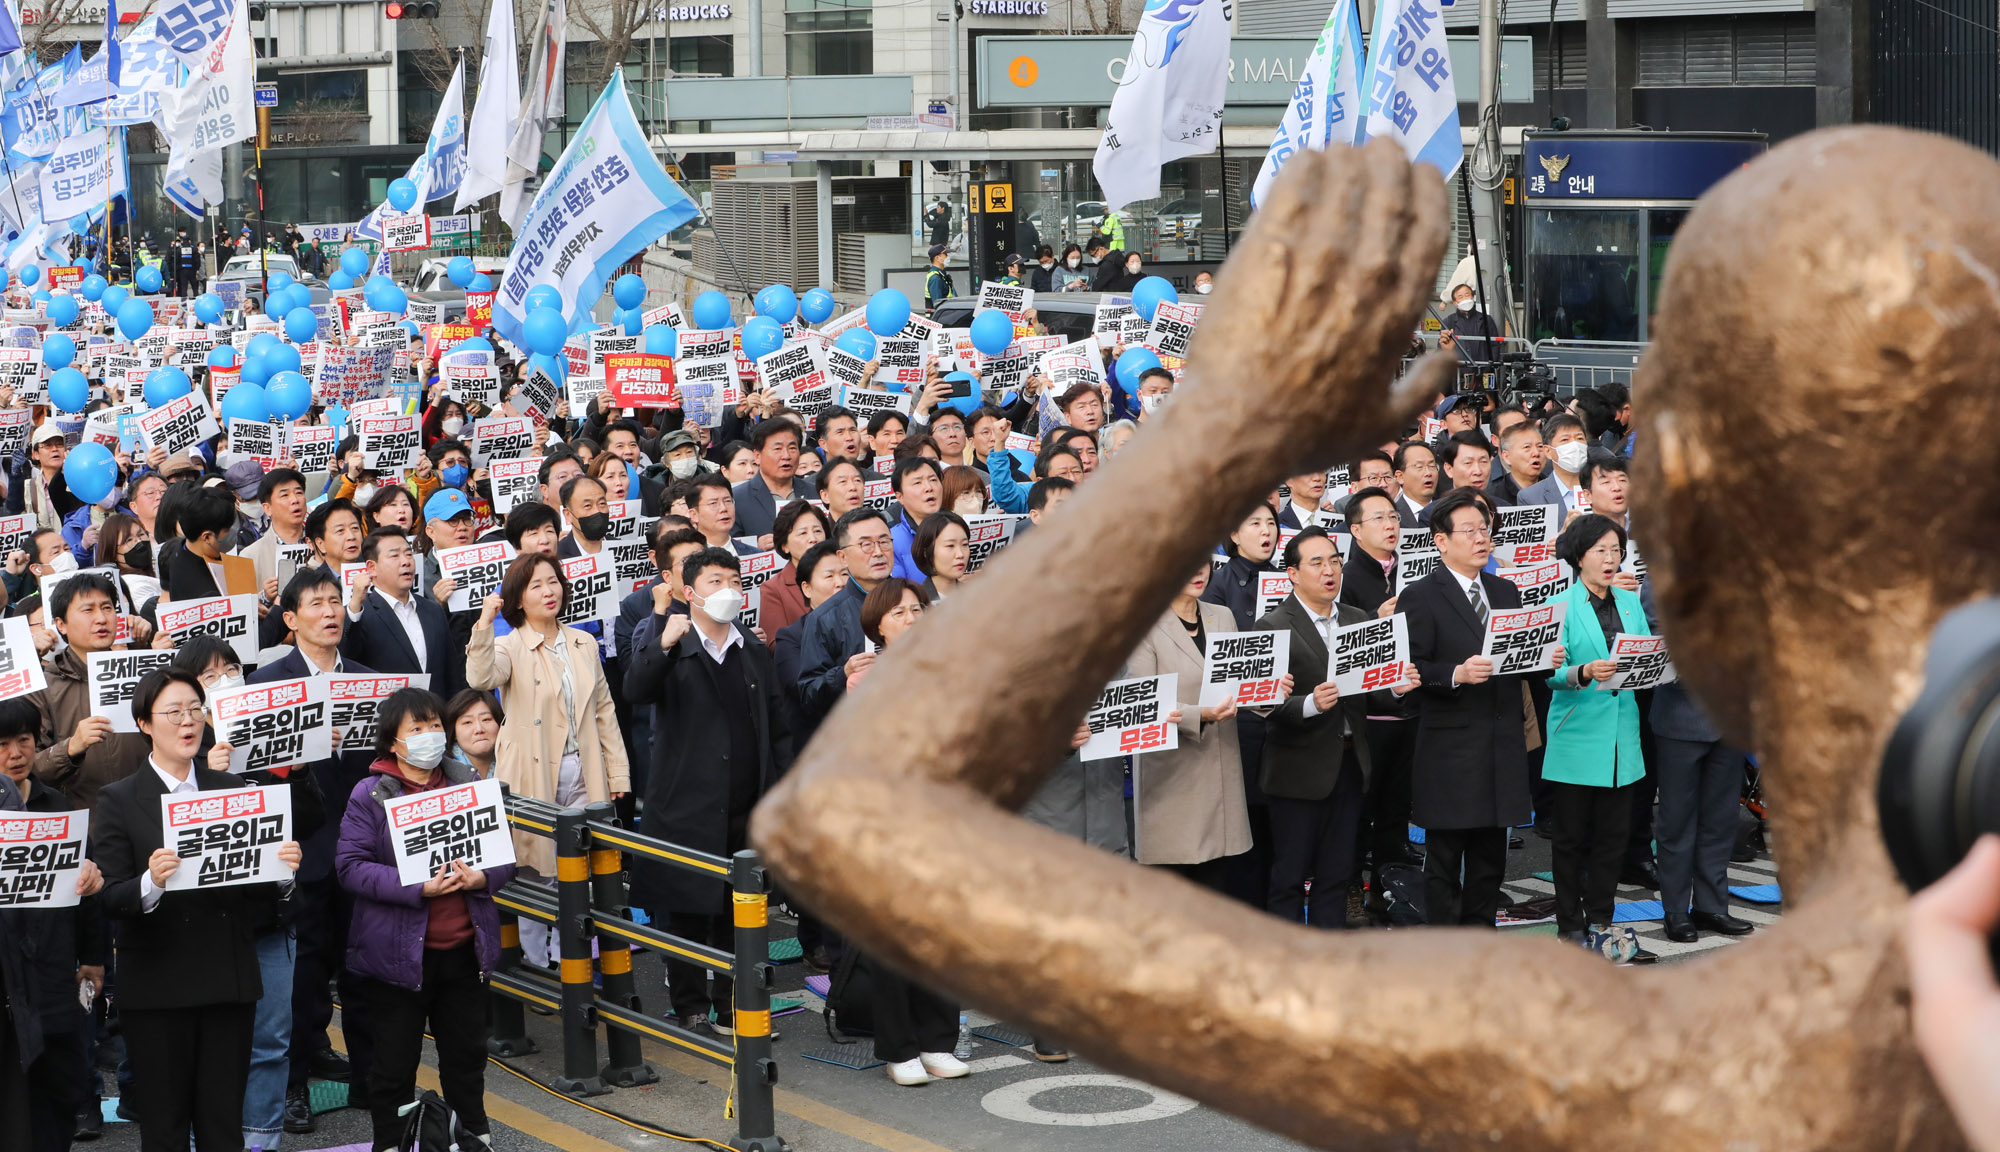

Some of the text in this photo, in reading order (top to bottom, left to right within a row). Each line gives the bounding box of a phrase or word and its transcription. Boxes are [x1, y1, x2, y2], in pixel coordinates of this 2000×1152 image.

[971, 0, 1048, 15] STARBUCKS
[1017, 62, 1029, 81] 4
[287, 132, 321, 143] PLACE
[1531, 175, 1594, 194] 교통 안내
[313, 218, 467, 241] 오세훈 그만두고
[984, 287, 1024, 300] 강제동원
[982, 298, 1022, 312] 굴욕해법
[431, 327, 474, 338] 친일역적
[1124, 320, 1151, 331] 강제동
[1155, 318, 1193, 339] 굴욕외
[371, 329, 405, 342] 강제동원
[594, 338, 637, 351] 강제동원
[681, 332, 722, 343] 윤석열 정부
[175, 341, 213, 353] 굴욕외교
[682, 340, 730, 358] 굴욕외교
[881, 341, 919, 354] 강제동원
[181, 352, 205, 365] 심판!
[609, 358, 642, 367] 민주파괴
[764, 345, 808, 373] 강제동원
[880, 355, 920, 368] 굴욕해법
[982, 356, 1028, 377] 굴욕외교
[109, 368, 125, 377] 굴욕
[448, 367, 486, 376] 윤석열 정부
[615, 368, 662, 381] 윤석열을
[685, 362, 726, 380] 강제동원
[768, 359, 815, 387] 굴욕해법
[897, 368, 924, 383] 무효!
[1054, 367, 1099, 384] 굴욕외교
[451, 378, 497, 391] 굴욕외교
[572, 379, 606, 391] 강제동
[621, 382, 669, 395] 타도하자!
[793, 370, 826, 393] 무효!
[991, 373, 1020, 389] 심판!
[723, 388, 737, 402] 효!
[849, 392, 899, 408] 강제동원
[143, 398, 191, 430] 윤석열 정부
[151, 404, 206, 447] 굴욕외교
[233, 424, 271, 439] 강제동원
[316, 429, 333, 439] 정부
[365, 418, 412, 432] 윤석열 정부
[478, 420, 523, 437] 윤석열 정부
[168, 427, 200, 455] 심판!
[233, 440, 272, 455] 굴욕해법
[366, 431, 419, 452] 굴욕외교
[479, 433, 533, 454] 굴욕외교
[376, 450, 409, 468] 심판!
[493, 460, 540, 477] 윤석열 정부
[871, 481, 892, 497] 정부
[1493, 526, 1546, 547] 굴욕해법
[445, 544, 505, 568] 윤석열 정부
[608, 543, 650, 562] 강제동
[752, 555, 774, 569] 정부
[1512, 543, 1549, 564] 무효!
[569, 559, 595, 576] 정부
[1538, 563, 1560, 580] 정부
[1264, 579, 1292, 595] 윤석
[164, 600, 230, 630] 윤석열 정부
[1492, 608, 1552, 631] 윤석열 정부
[1336, 618, 1393, 655] 강제동원
[1491, 622, 1560, 656] 굴욕외교
[1211, 633, 1274, 660] 강제동원
[1619, 640, 1652, 654] 윤석열
[96, 651, 176, 682] 강제동원
[1335, 641, 1396, 676] 굴욕해법
[1500, 648, 1542, 672] 심판!
[1210, 656, 1274, 684] 굴욕해법
[1361, 660, 1404, 690] 무효!
[1620, 664, 1662, 689] 심판!
[0, 669, 31, 699] 효!
[331, 678, 408, 698] 윤석열 정부
[1236, 678, 1280, 705] 무효!
[100, 682, 136, 706] 굴욕
[220, 683, 303, 717] 윤석열 정부
[226, 702, 325, 746] 굴욕외교
[1088, 700, 1158, 734] 굴욕해법
[1120, 722, 1168, 753] 무효!
[245, 732, 304, 771] 심판!
[170, 791, 264, 825] 윤석열 정부
[395, 787, 478, 825] 윤석열 정부
[30, 817, 67, 840] 정부
[177, 815, 284, 857] 굴욕외교
[403, 804, 500, 857] 굴욕외교
[0, 839, 82, 875] 욕외교
[428, 839, 482, 878] 심판!
[198, 848, 261, 887] 심판!
